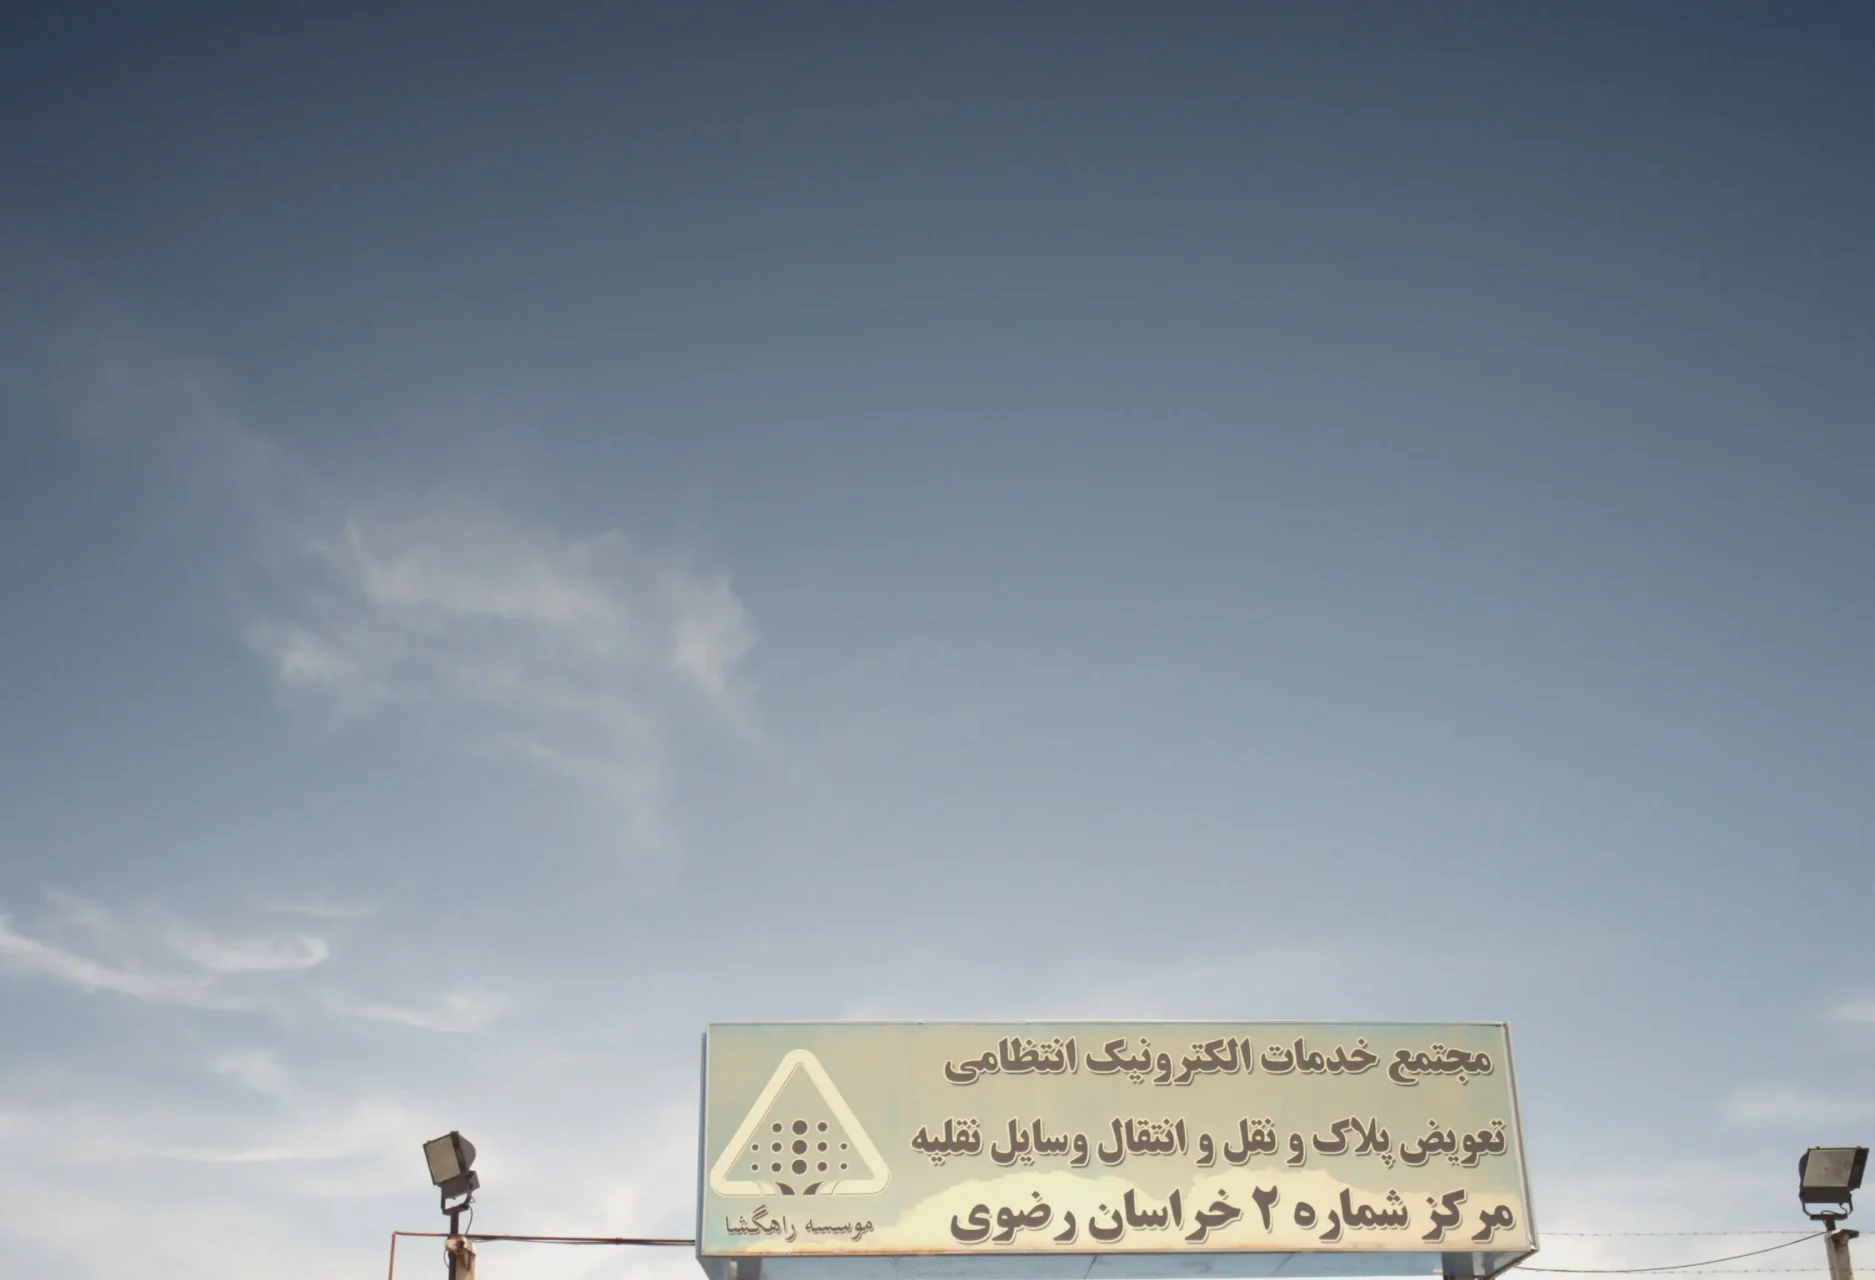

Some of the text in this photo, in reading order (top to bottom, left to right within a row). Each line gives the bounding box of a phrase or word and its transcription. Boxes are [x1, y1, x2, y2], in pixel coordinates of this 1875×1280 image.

[944, 1036, 1493, 1085] مجتمع خدمات الکترونیک انتظامی
[911, 1116, 1507, 1168] تعویض پلاک و نقل و انتقال وسایل نقلیه
[725, 1203, 874, 1243] موسسه راهگشا
[950, 1184, 1516, 1244] مرکز شماره ۲ خراسان رضوی
